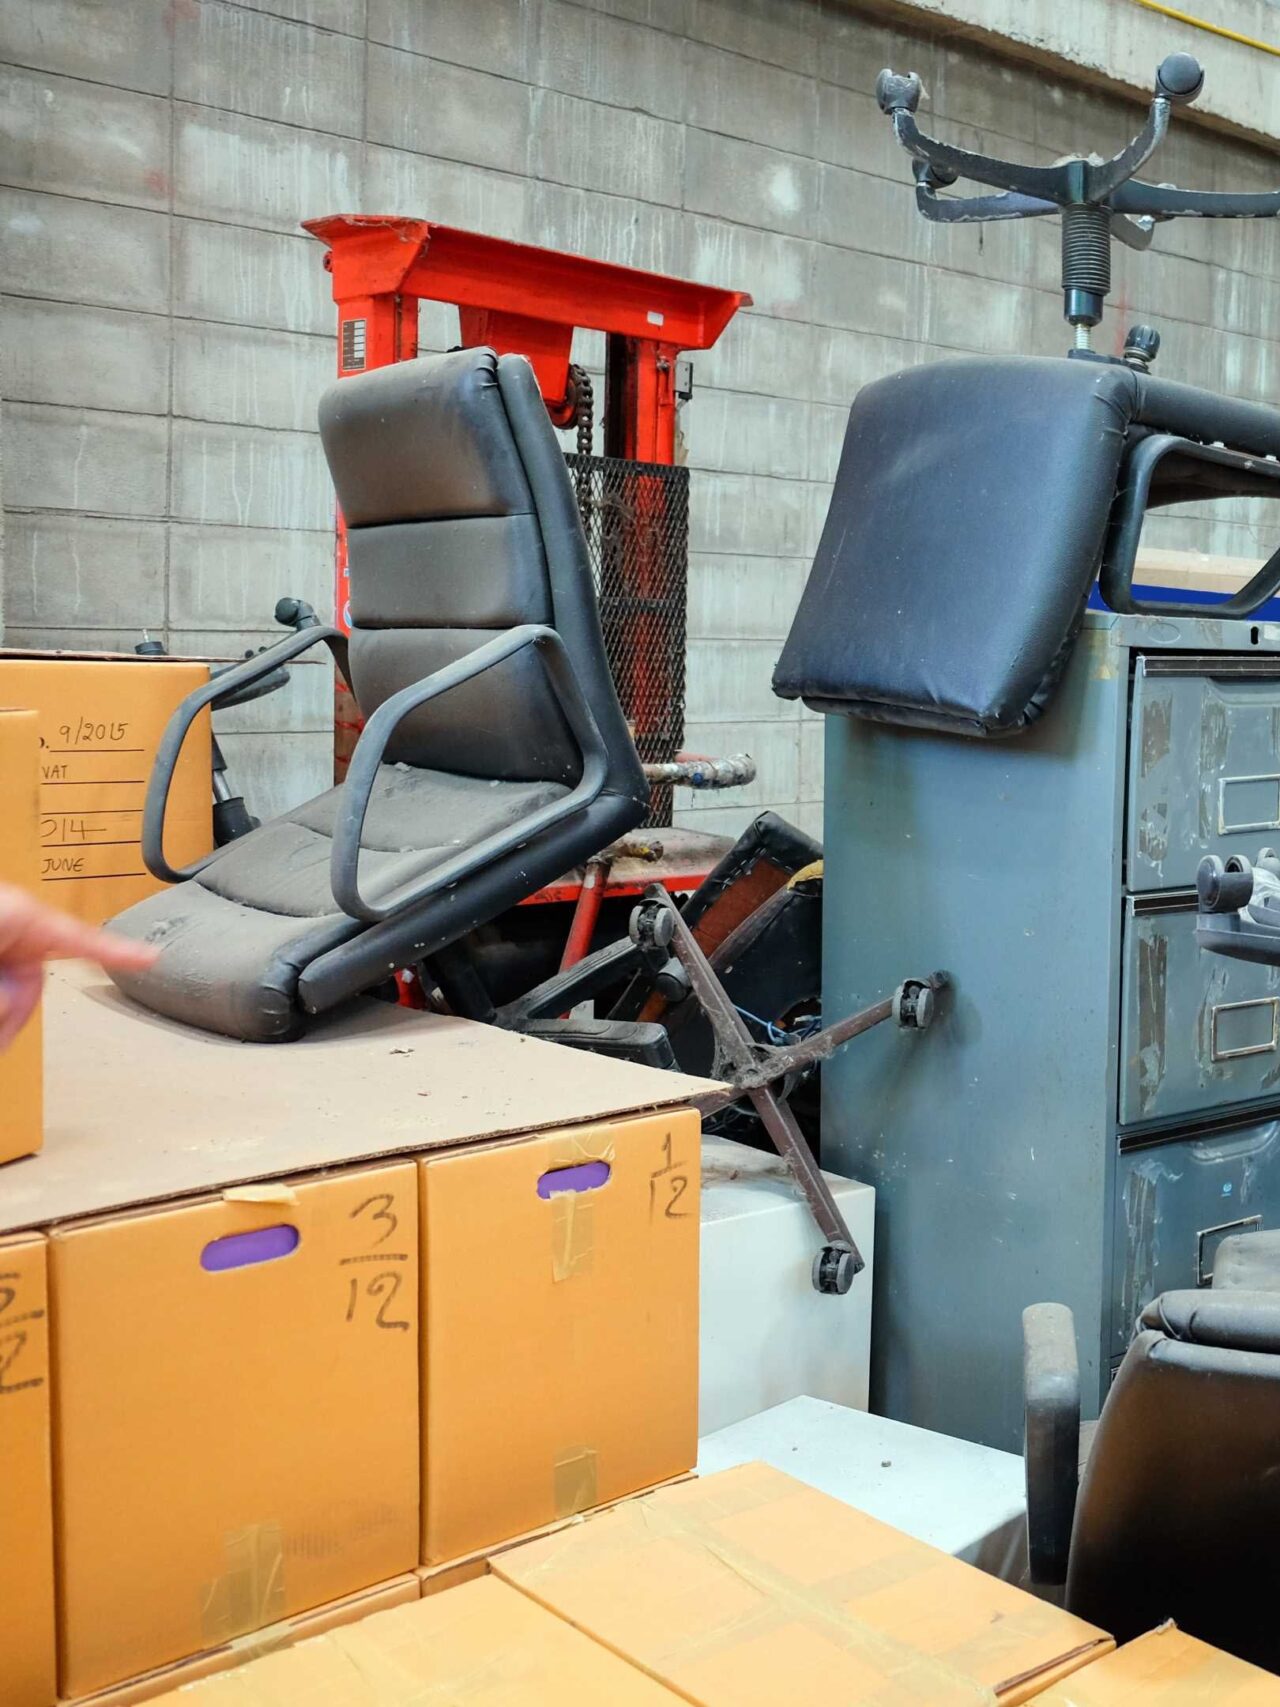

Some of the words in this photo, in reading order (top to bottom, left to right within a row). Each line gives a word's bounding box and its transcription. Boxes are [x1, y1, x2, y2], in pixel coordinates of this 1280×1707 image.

[59, 716, 129, 745] 9/2015
[42, 764, 69, 780] VAT
[41, 857, 85, 874] JUNE
[349, 1193, 398, 1249] 3
[649, 1175, 695, 1227] 12
[345, 1271, 410, 1331] 12
